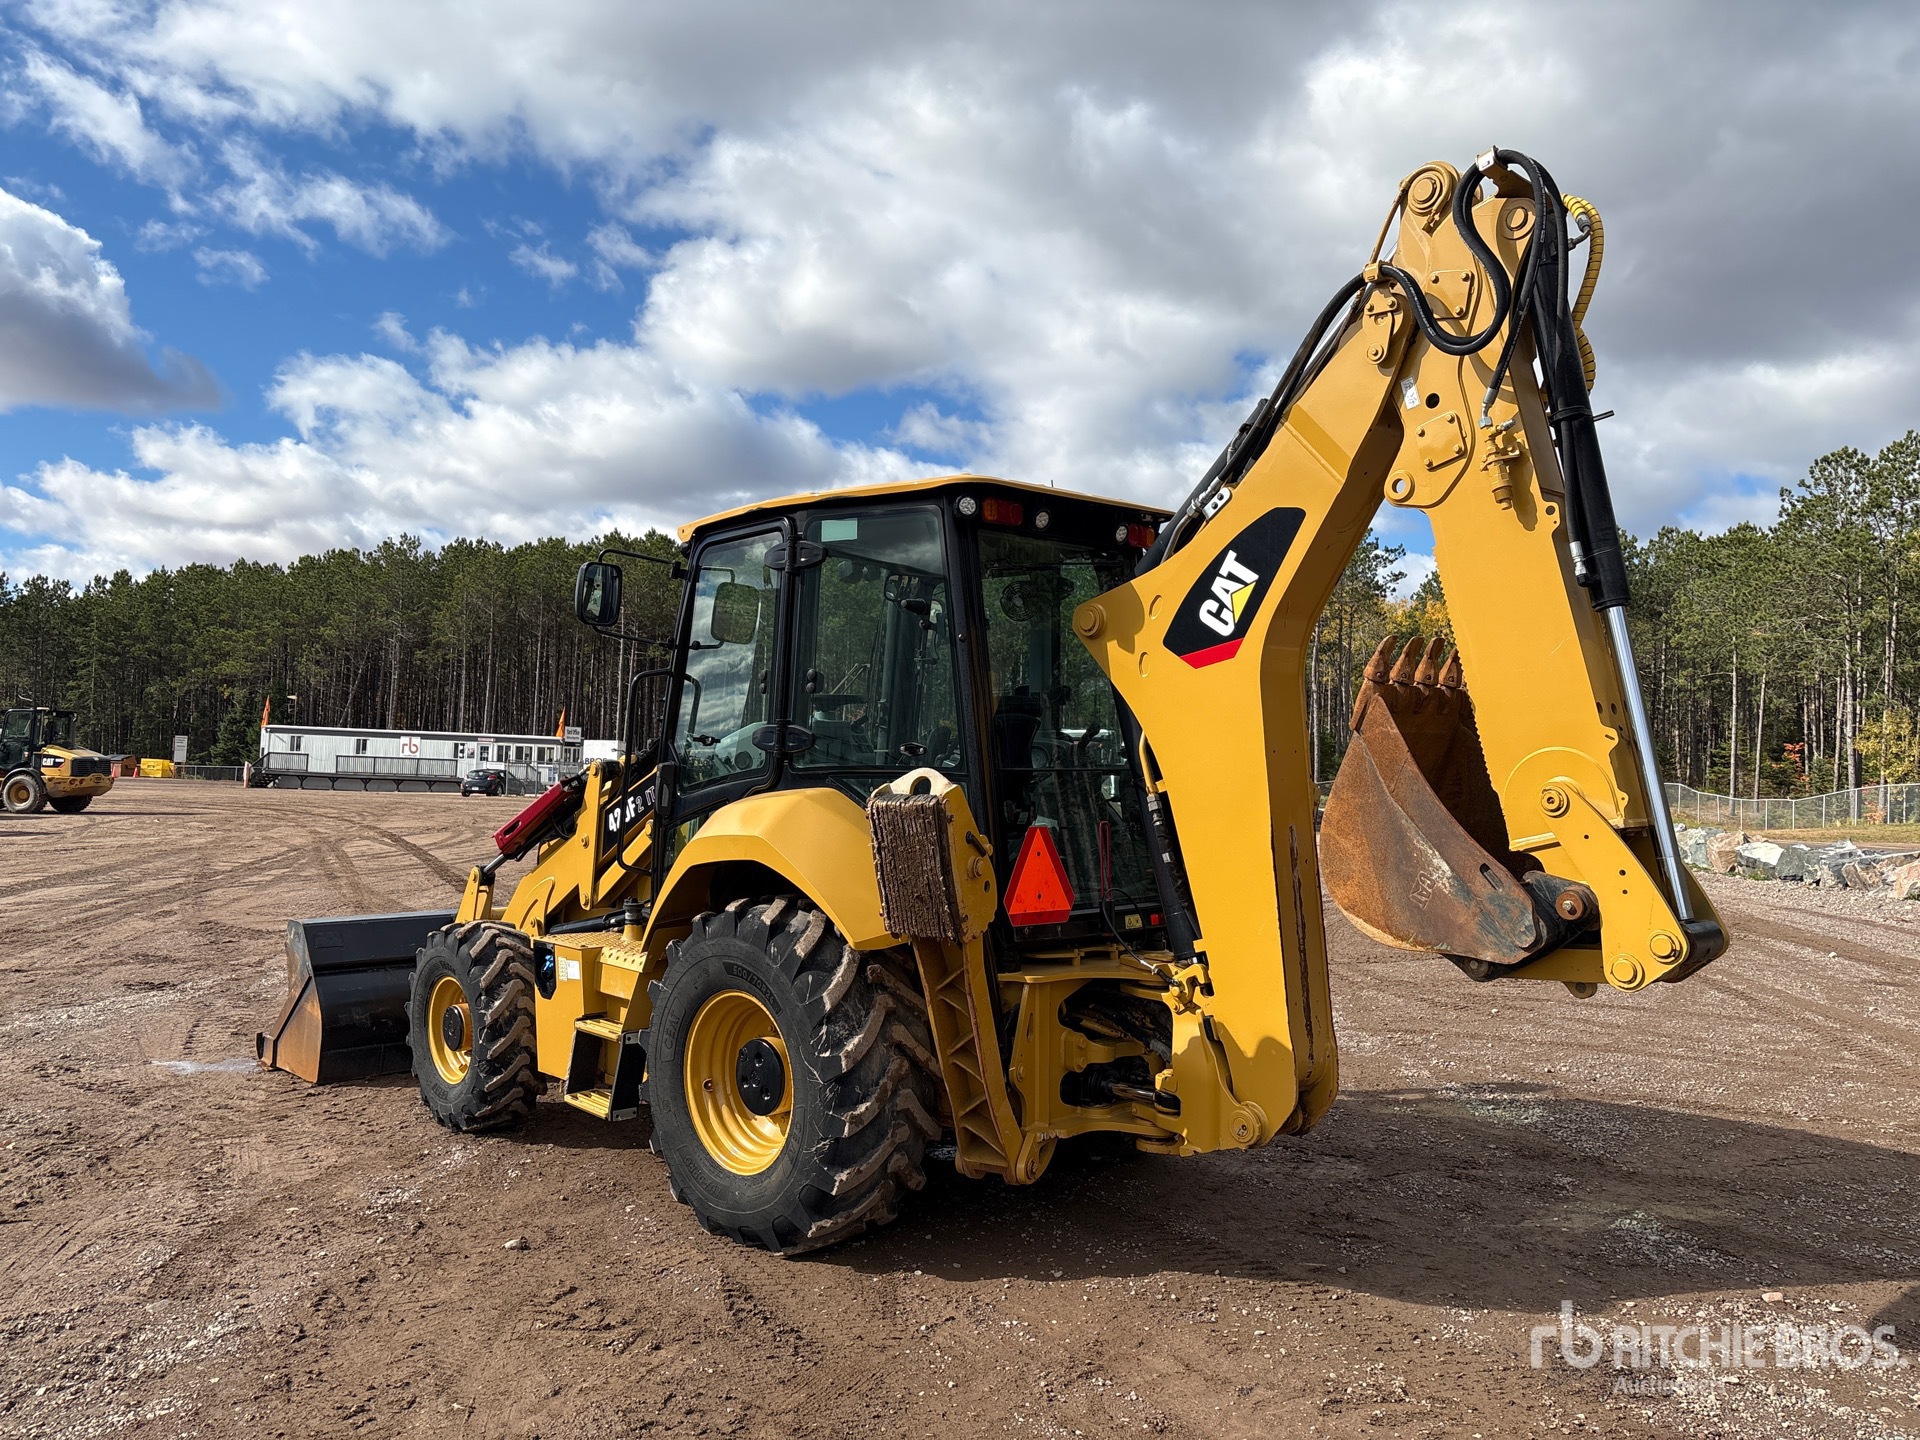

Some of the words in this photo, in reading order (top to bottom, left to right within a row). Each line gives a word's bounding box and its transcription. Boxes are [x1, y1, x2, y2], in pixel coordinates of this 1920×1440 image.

[1198, 549, 1260, 637] CAT
[401, 737, 419, 754] rb
[42, 757, 55, 766] CAT
[1409, 870, 1437, 910] CAT
